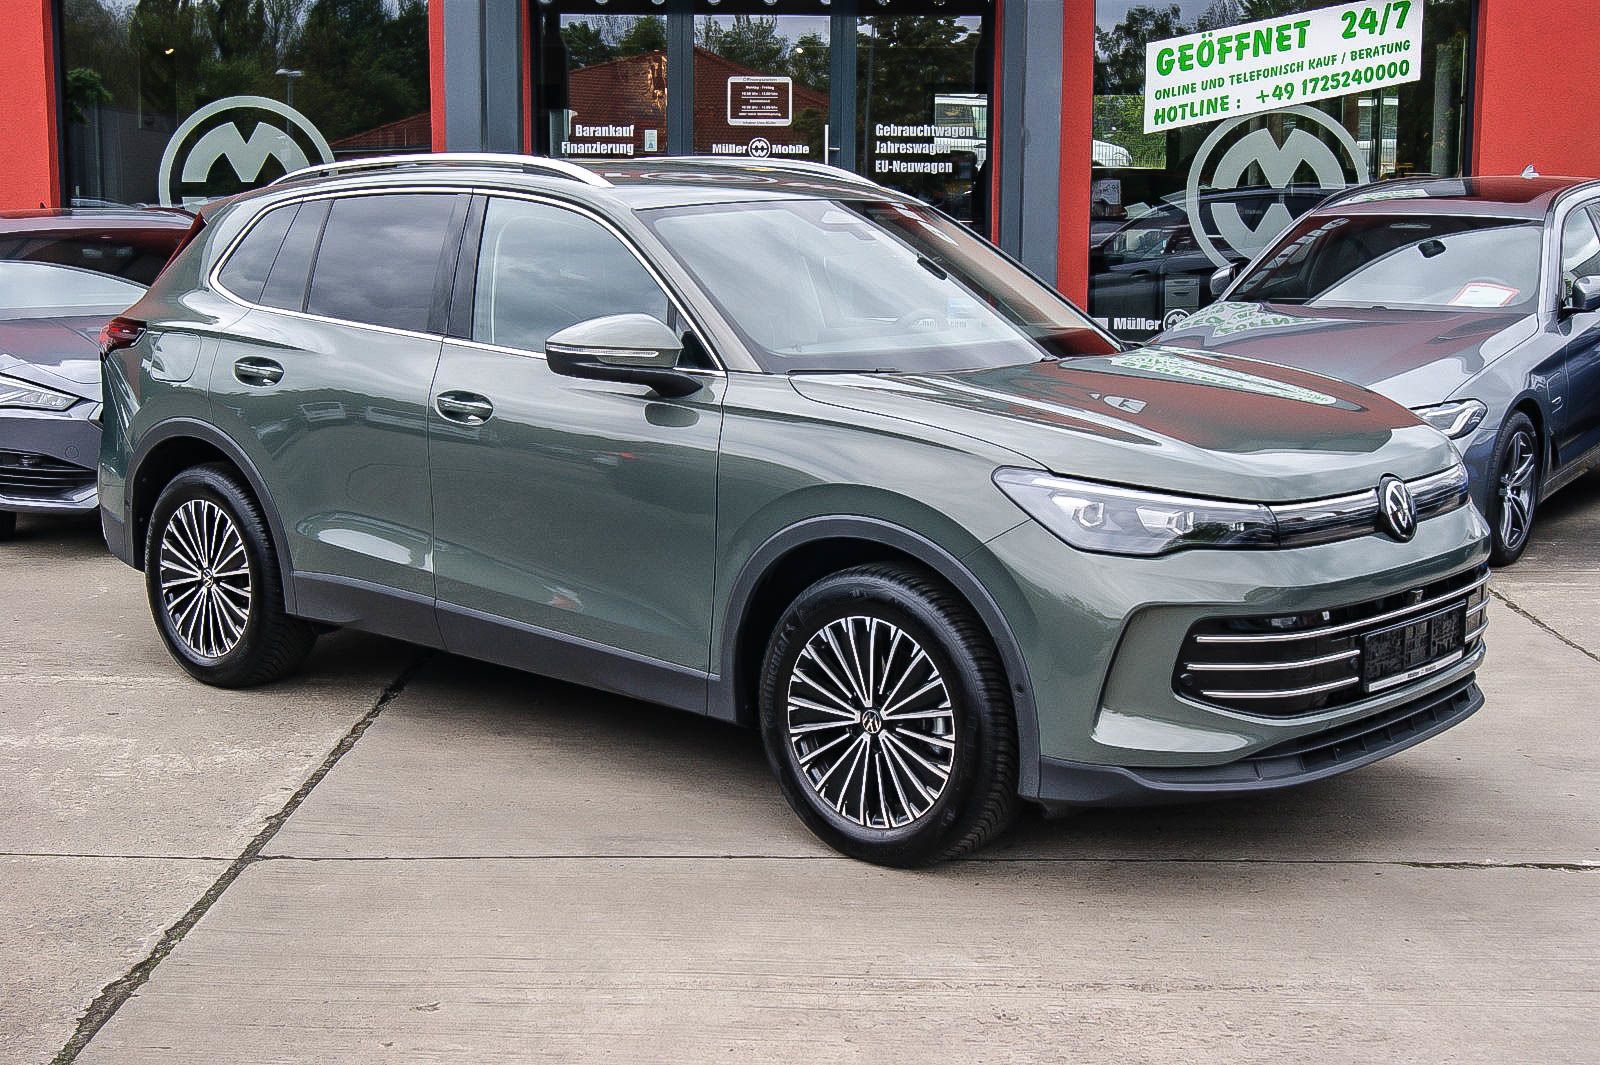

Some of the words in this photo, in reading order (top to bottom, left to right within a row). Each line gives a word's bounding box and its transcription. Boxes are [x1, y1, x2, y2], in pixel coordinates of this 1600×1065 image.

[1156, 20, 1311, 76] GEÖFFNET
[1341, 1, 1412, 40] 24/7
[1155, 83, 1197, 100] ONLINE
[1201, 77, 1225, 91] UND
[1229, 61, 1304, 85] TELEFONISCH
[1308, 54, 1337, 70] KAUF
[1350, 39, 1411, 62] BERATUNG
[1154, 95, 1230, 125] HOTLINE
[1256, 82, 1295, 103] +49
[1302, 59, 1410, 96] 1725240000
[575, 125, 634, 137] Barankauf
[875, 123, 974, 138] Gebrauchtwagen
[561, 141, 635, 156] Finanzierung
[712, 143, 748, 155] Müller
[772, 143, 810, 155] Mobile
[875, 140, 951, 155] Jahreswagen
[875, 160, 952, 174] EU-Neuwagen
[1113, 317, 1162, 331] Müller
